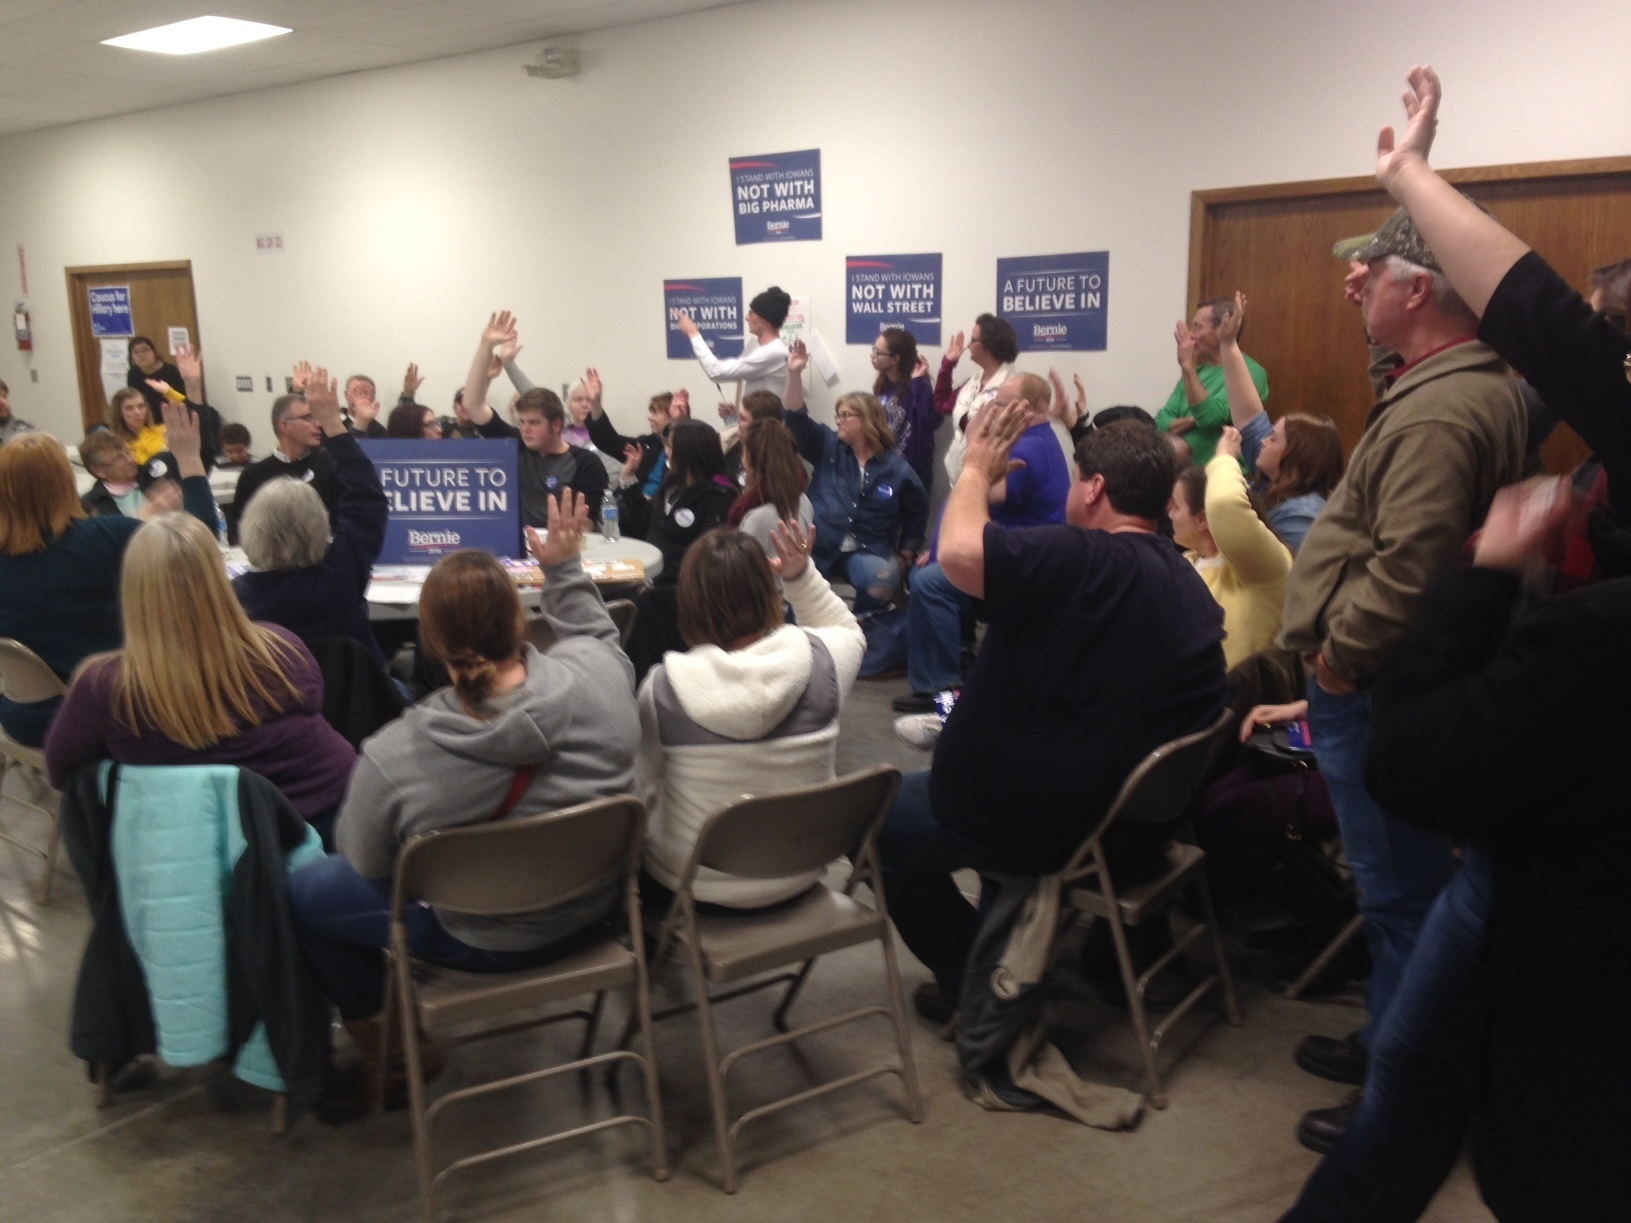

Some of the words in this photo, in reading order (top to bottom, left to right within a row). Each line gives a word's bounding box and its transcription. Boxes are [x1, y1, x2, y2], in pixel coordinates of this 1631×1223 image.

[741, 173, 764, 183] STAND
[765, 172, 785, 181] WITH
[785, 168, 814, 179] IOWANS
[737, 183, 770, 201] NOT
[774, 179, 815, 198] WITH
[739, 201, 760, 215] BIG
[762, 196, 815, 213] PHARMA
[856, 273, 880, 283] STAND
[881, 272, 901, 282] WITH
[902, 271, 935, 282] IOWANS
[1004, 278, 1014, 293] A
[1017, 276, 1075, 293] FUTURE
[1079, 273, 1101, 290] TO
[693, 296, 710, 304] WITH
[852, 284, 886, 300] NOT
[890, 283, 935, 300] WITH
[852, 301, 885, 314] WALL
[887, 301, 934, 314] STREET
[1003, 293, 1076, 312] BELIEVE
[1080, 291, 1101, 309] IN
[669, 306, 698, 321] NOT
[700, 305, 738, 320] WITH
[696, 321, 738, 330] PORATIONS
[1033, 322, 1068, 337] Bernie
[381, 467, 470, 487] FUTURE
[474, 466, 507, 487] TO
[383, 489, 471, 512] LIEVE
[478, 489, 508, 512] IN
[408, 529, 461, 546] Bernie
